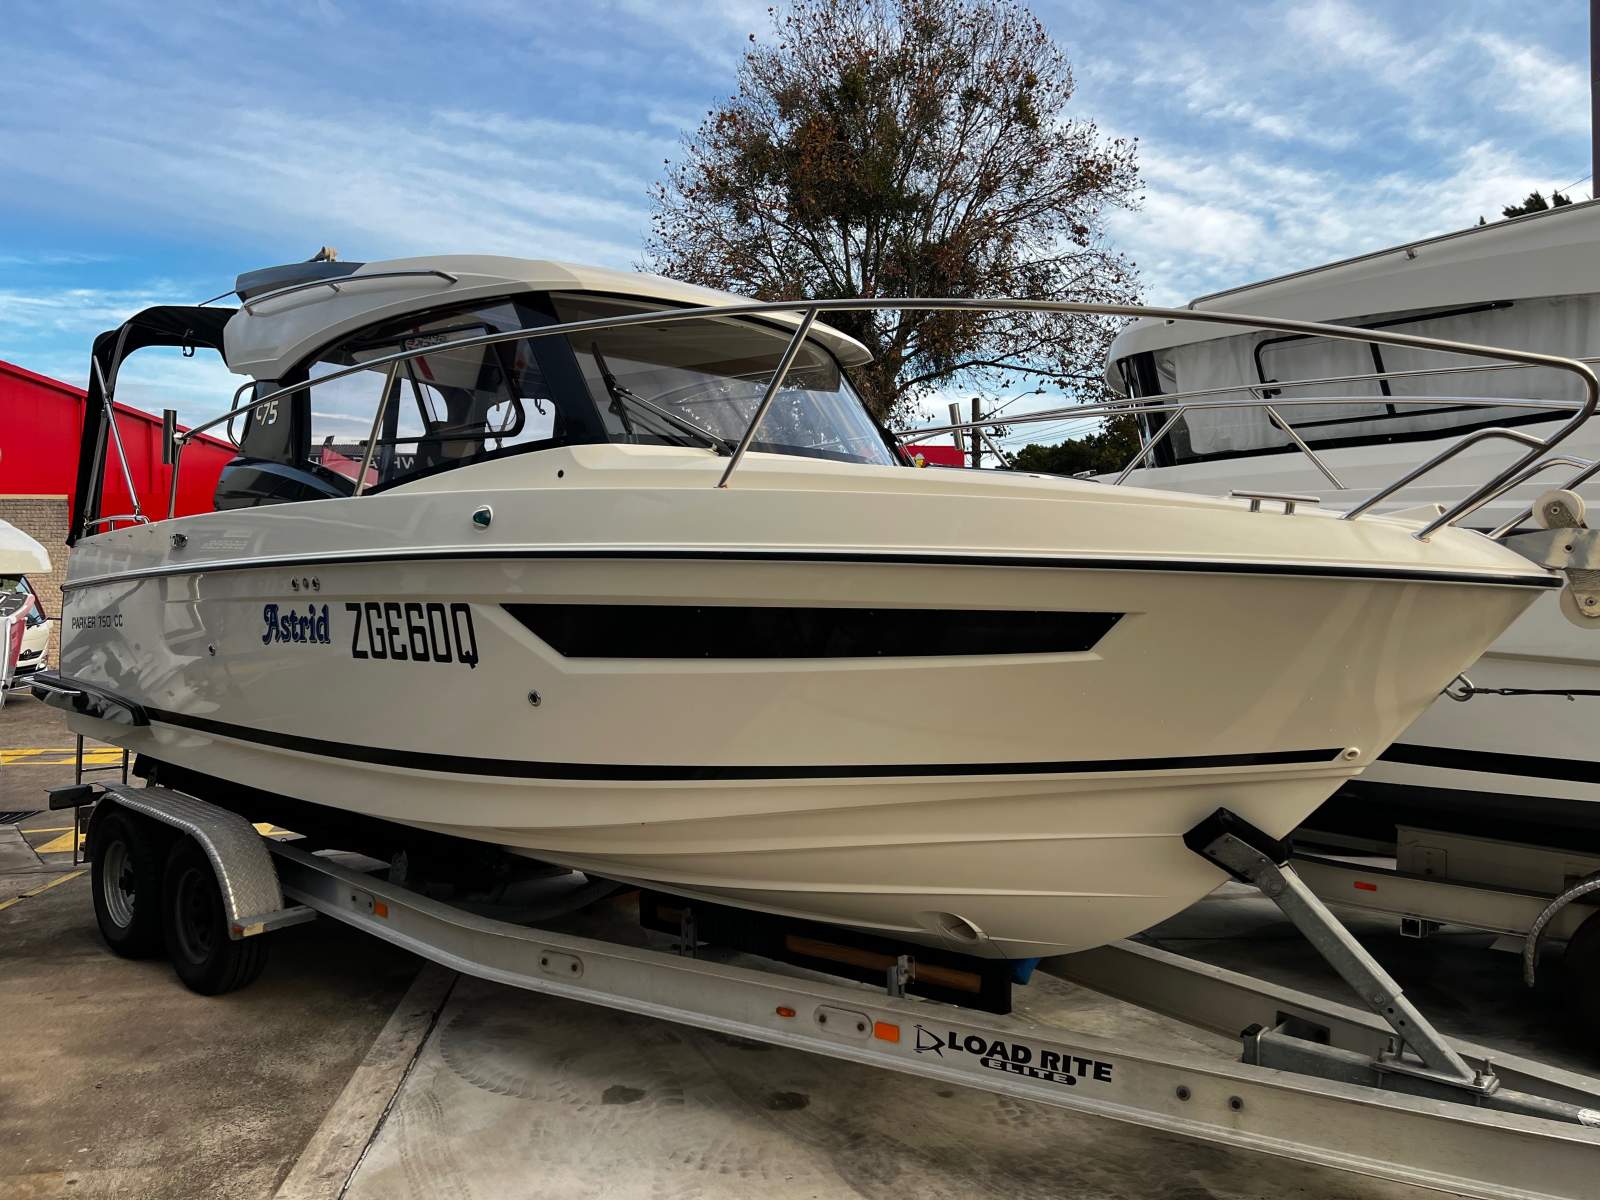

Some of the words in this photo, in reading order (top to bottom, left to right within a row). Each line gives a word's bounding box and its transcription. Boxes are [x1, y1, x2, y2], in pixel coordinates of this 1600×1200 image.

[71, 615, 96, 630] PARKER
[98, 615, 112, 628] 750
[113, 614, 123, 628] CC
[262, 603, 331, 645] Astrid
[345, 602, 479, 669] ZGE60Q
[948, 1031, 1032, 1065] LOAD
[1040, 1050, 1113, 1083] RITE
[988, 1059, 1069, 1084] ELITE
